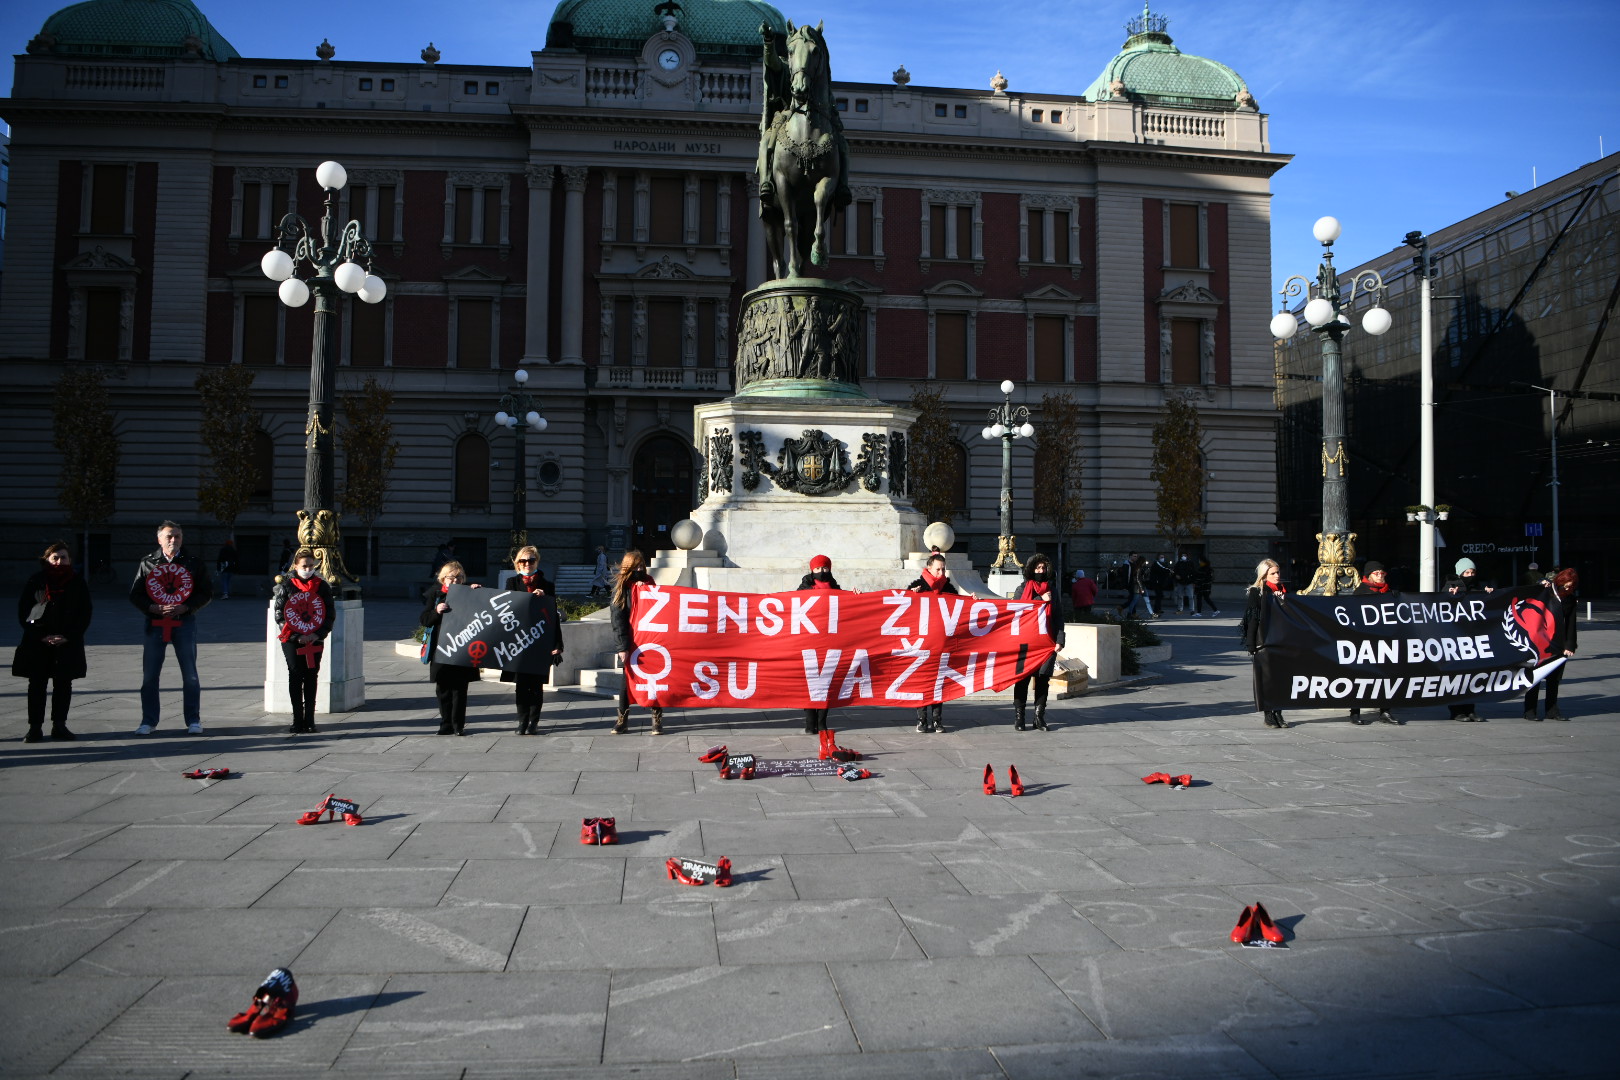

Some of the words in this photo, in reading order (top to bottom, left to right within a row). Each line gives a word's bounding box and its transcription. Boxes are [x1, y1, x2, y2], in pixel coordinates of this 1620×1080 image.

[614, 140, 675, 152] НАРОДНИ
[685, 143, 721, 154] МУЗЕЈ
[153, 564, 186, 577] STOP
[290, 592, 311, 605] STOP
[489, 590, 520, 632] Lives
[638, 585, 839, 636] ŽENSKI
[881, 589, 1048, 637] ŽIVOTI
[1334, 605, 1356, 627] 6.
[1361, 600, 1487, 627] DECEMBAR
[437, 610, 493, 658] Women's
[1337, 639, 1400, 665] DAN
[1406, 634, 1495, 664] BORBE
[691, 661, 758, 700] SU
[1290, 674, 1404, 700] PROTIV
[1404, 667, 1533, 699] FEMICIDA
[729, 756, 753, 765] STANKA
[331, 800, 354, 811] VINKA
[683, 861, 717, 875] DRAGANA
[691, 870, 704, 880] 52
